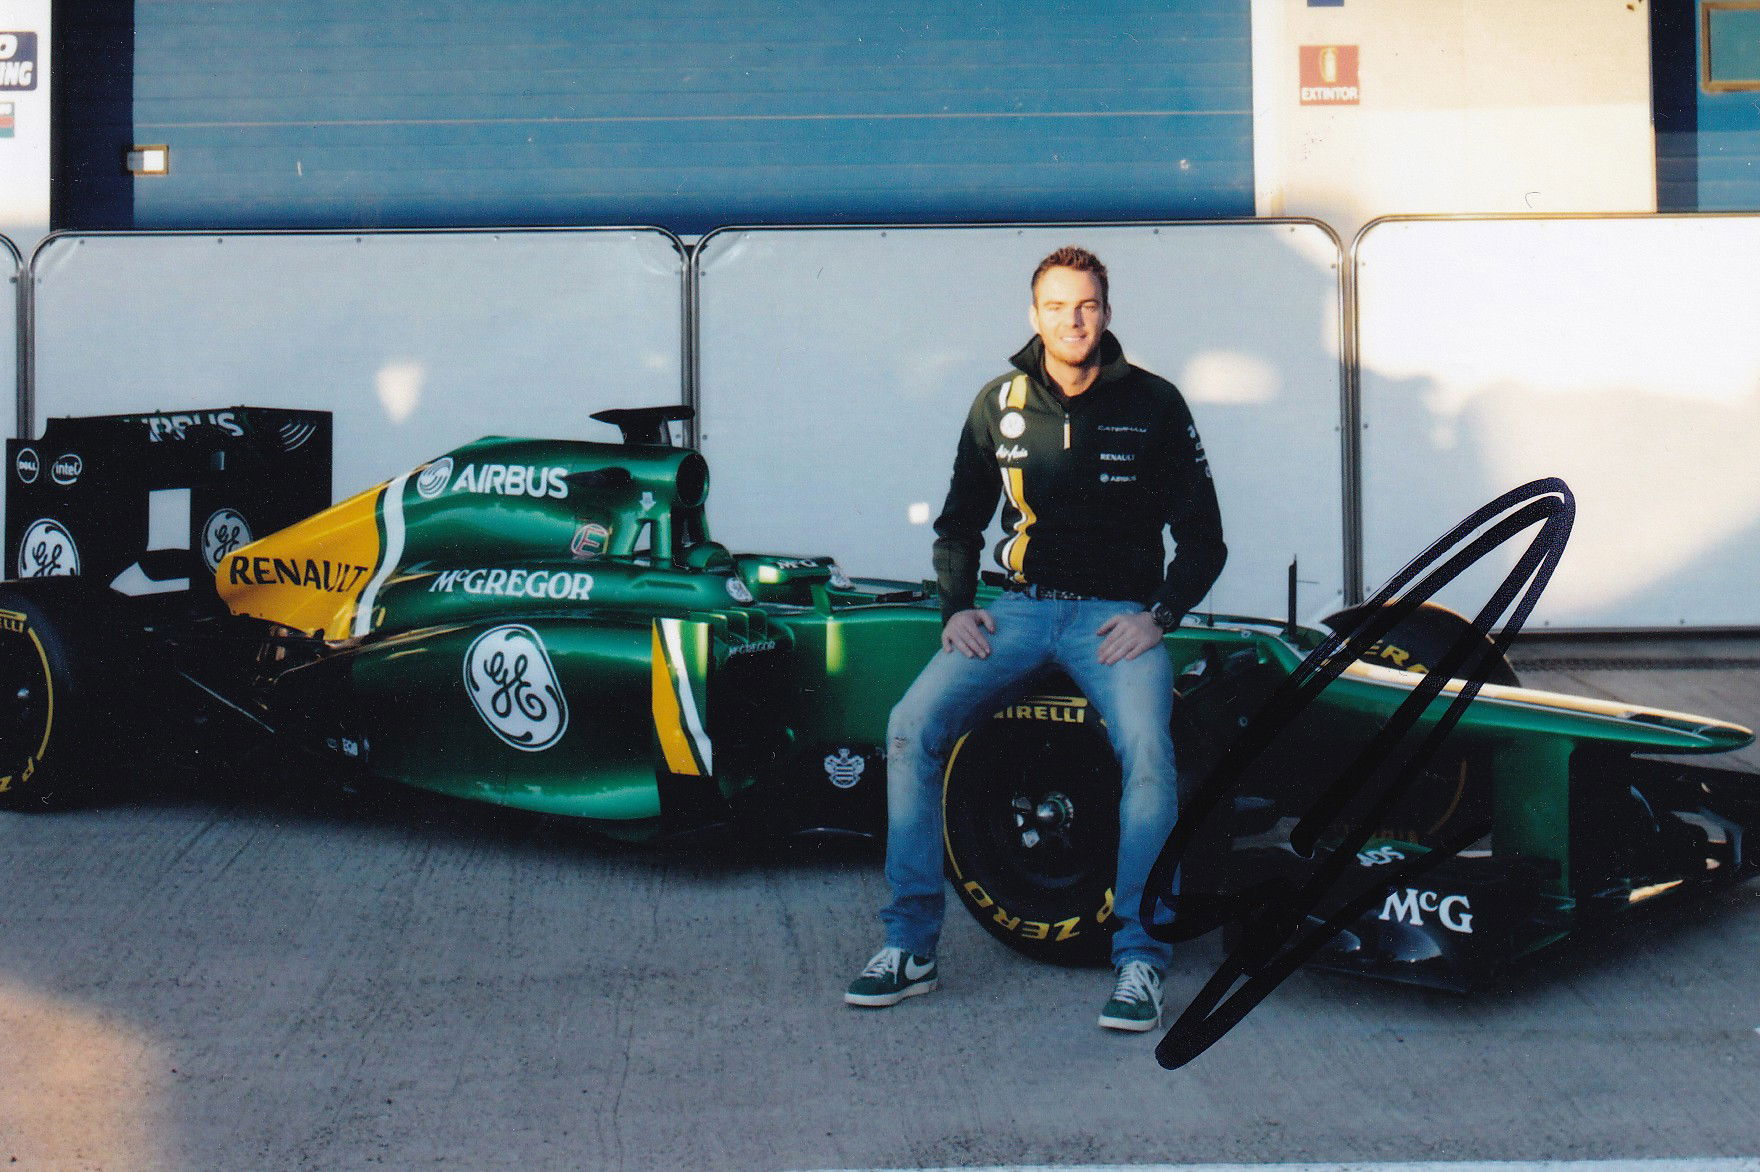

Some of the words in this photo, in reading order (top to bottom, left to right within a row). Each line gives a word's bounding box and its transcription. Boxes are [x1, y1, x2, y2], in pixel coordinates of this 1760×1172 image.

[1301, 87, 1358, 100] EXTINTOR
[55, 462, 79, 476] intel
[452, 463, 569, 499] AIRBUS
[229, 555, 368, 594] RENAULT
[964, 881, 1081, 942] ZERO
